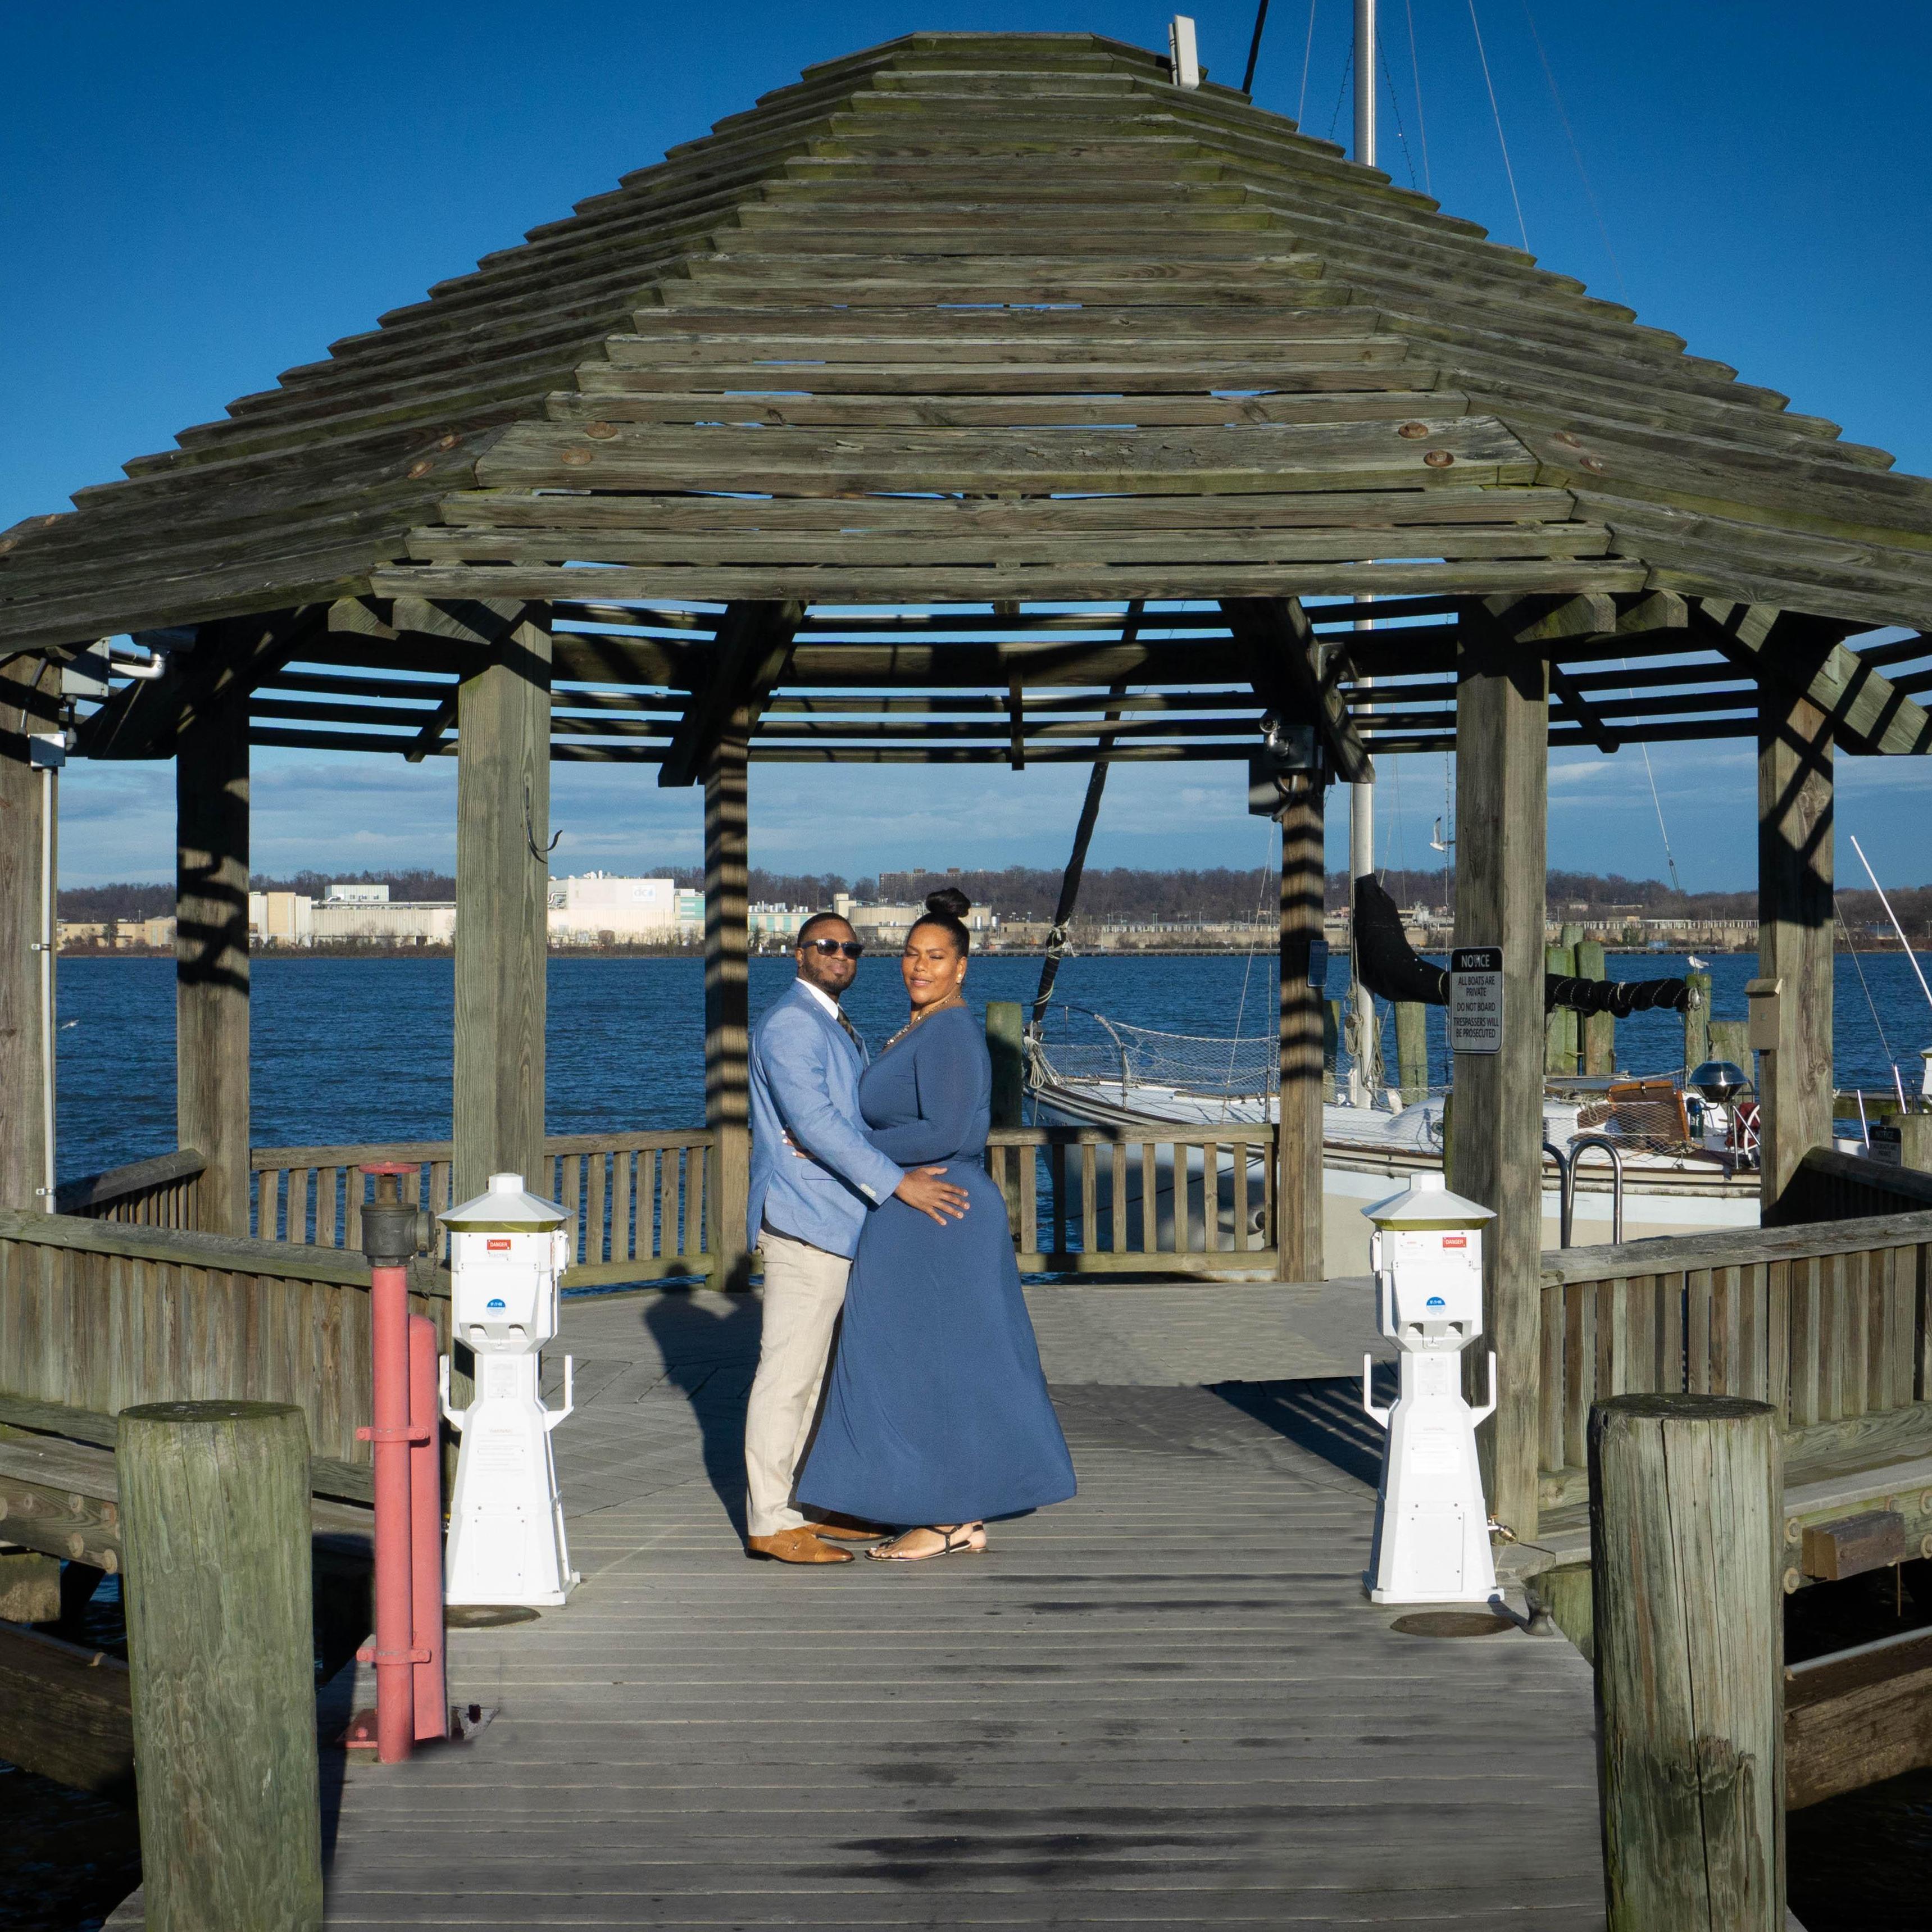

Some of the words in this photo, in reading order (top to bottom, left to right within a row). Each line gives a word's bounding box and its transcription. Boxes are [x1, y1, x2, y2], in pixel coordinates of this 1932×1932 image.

[1461, 954, 1490, 968] NOTICE
[1458, 976, 1467, 986] ALL
[1468, 976, 1485, 985] BOATS
[1485, 975, 1495, 985] ARE
[1466, 987, 1487, 997] PRIVATE
[1457, 1002, 1464, 1012] DO
[1466, 1002, 1476, 1012] NOT
[1478, 1002, 1495, 1012] BOARD
[1453, 1017, 1486, 1027] TRESPASSERS
[1486, 1017, 1499, 1027] WILL
[1456, 1028, 1462, 1038] BE
[1463, 1028, 1495, 1038] PROSECUTED
